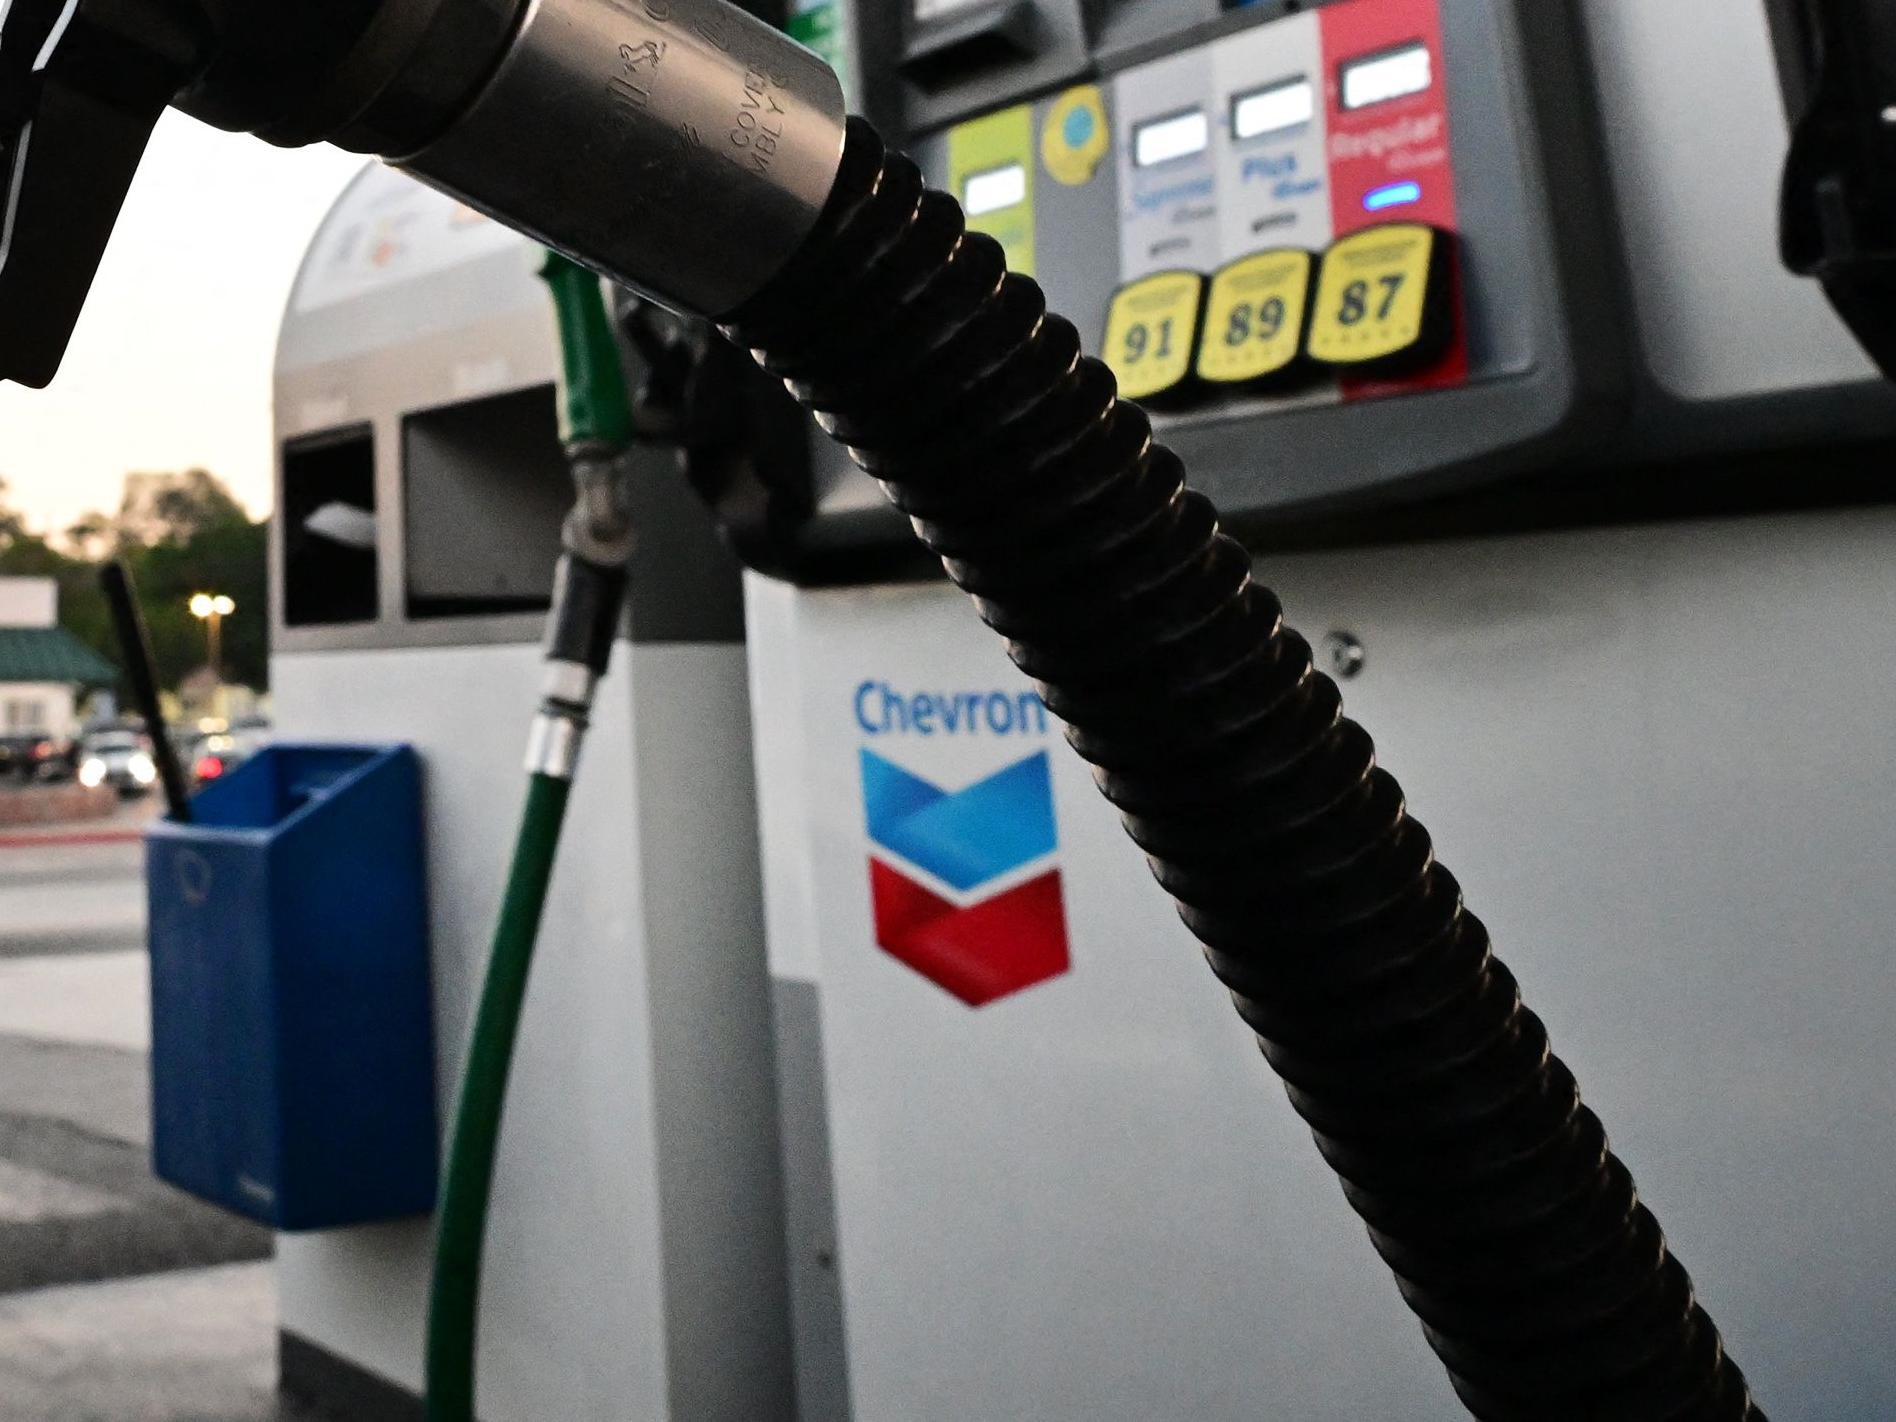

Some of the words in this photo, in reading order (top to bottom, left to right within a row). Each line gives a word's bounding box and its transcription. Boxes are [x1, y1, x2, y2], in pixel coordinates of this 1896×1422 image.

[1223, 296, 1287, 347] 89
[1337, 273, 1407, 327] 87
[1123, 316, 1174, 365] 91
[854, 679, 1049, 737] Chevron
